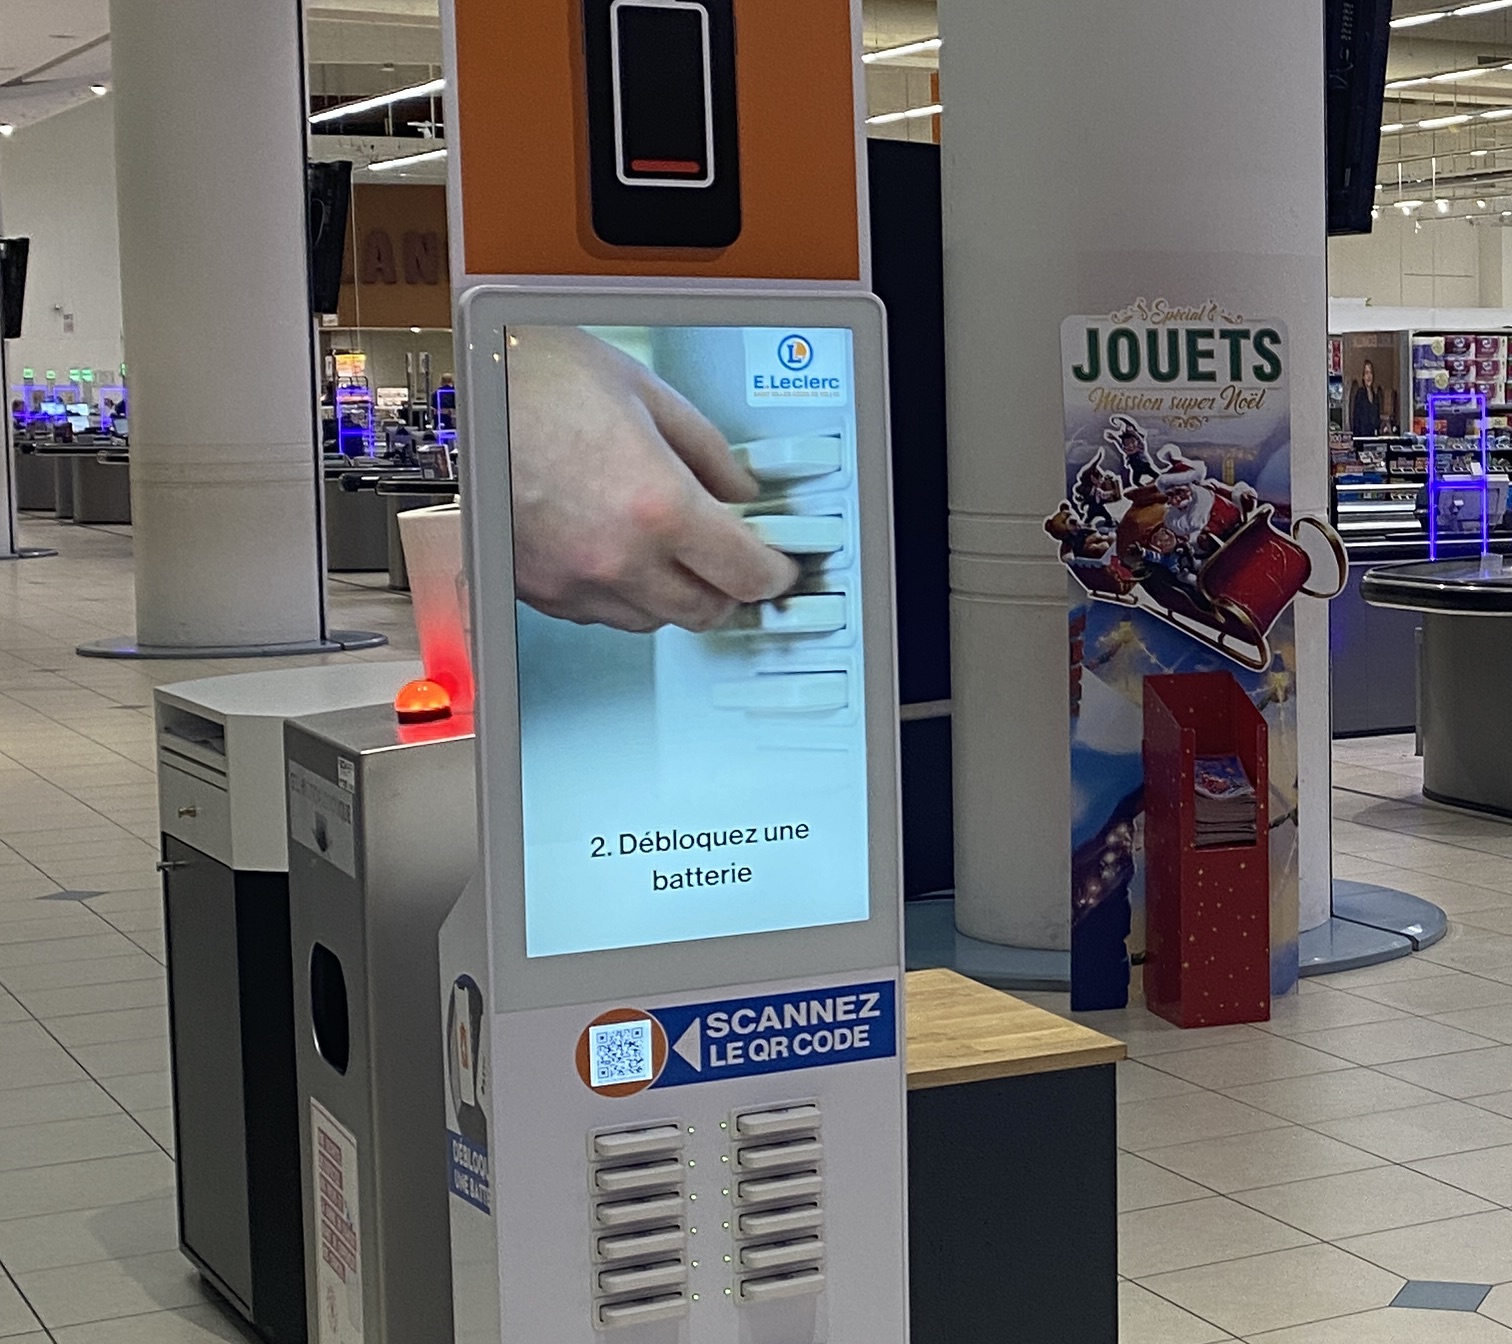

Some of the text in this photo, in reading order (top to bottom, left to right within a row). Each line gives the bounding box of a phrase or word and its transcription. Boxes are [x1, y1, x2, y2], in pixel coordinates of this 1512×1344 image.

[1072, 327, 1283, 383] JOUETS
[753, 375, 840, 389] E.Leclerc
[1088, 385, 1267, 416] Mission super Noël
[590, 823, 810, 858] 2. Débloquez une
[653, 862, 752, 891] batterie
[705, 991, 881, 1038] SCANNEZ
[709, 1024, 870, 1067] LE QR CODE
